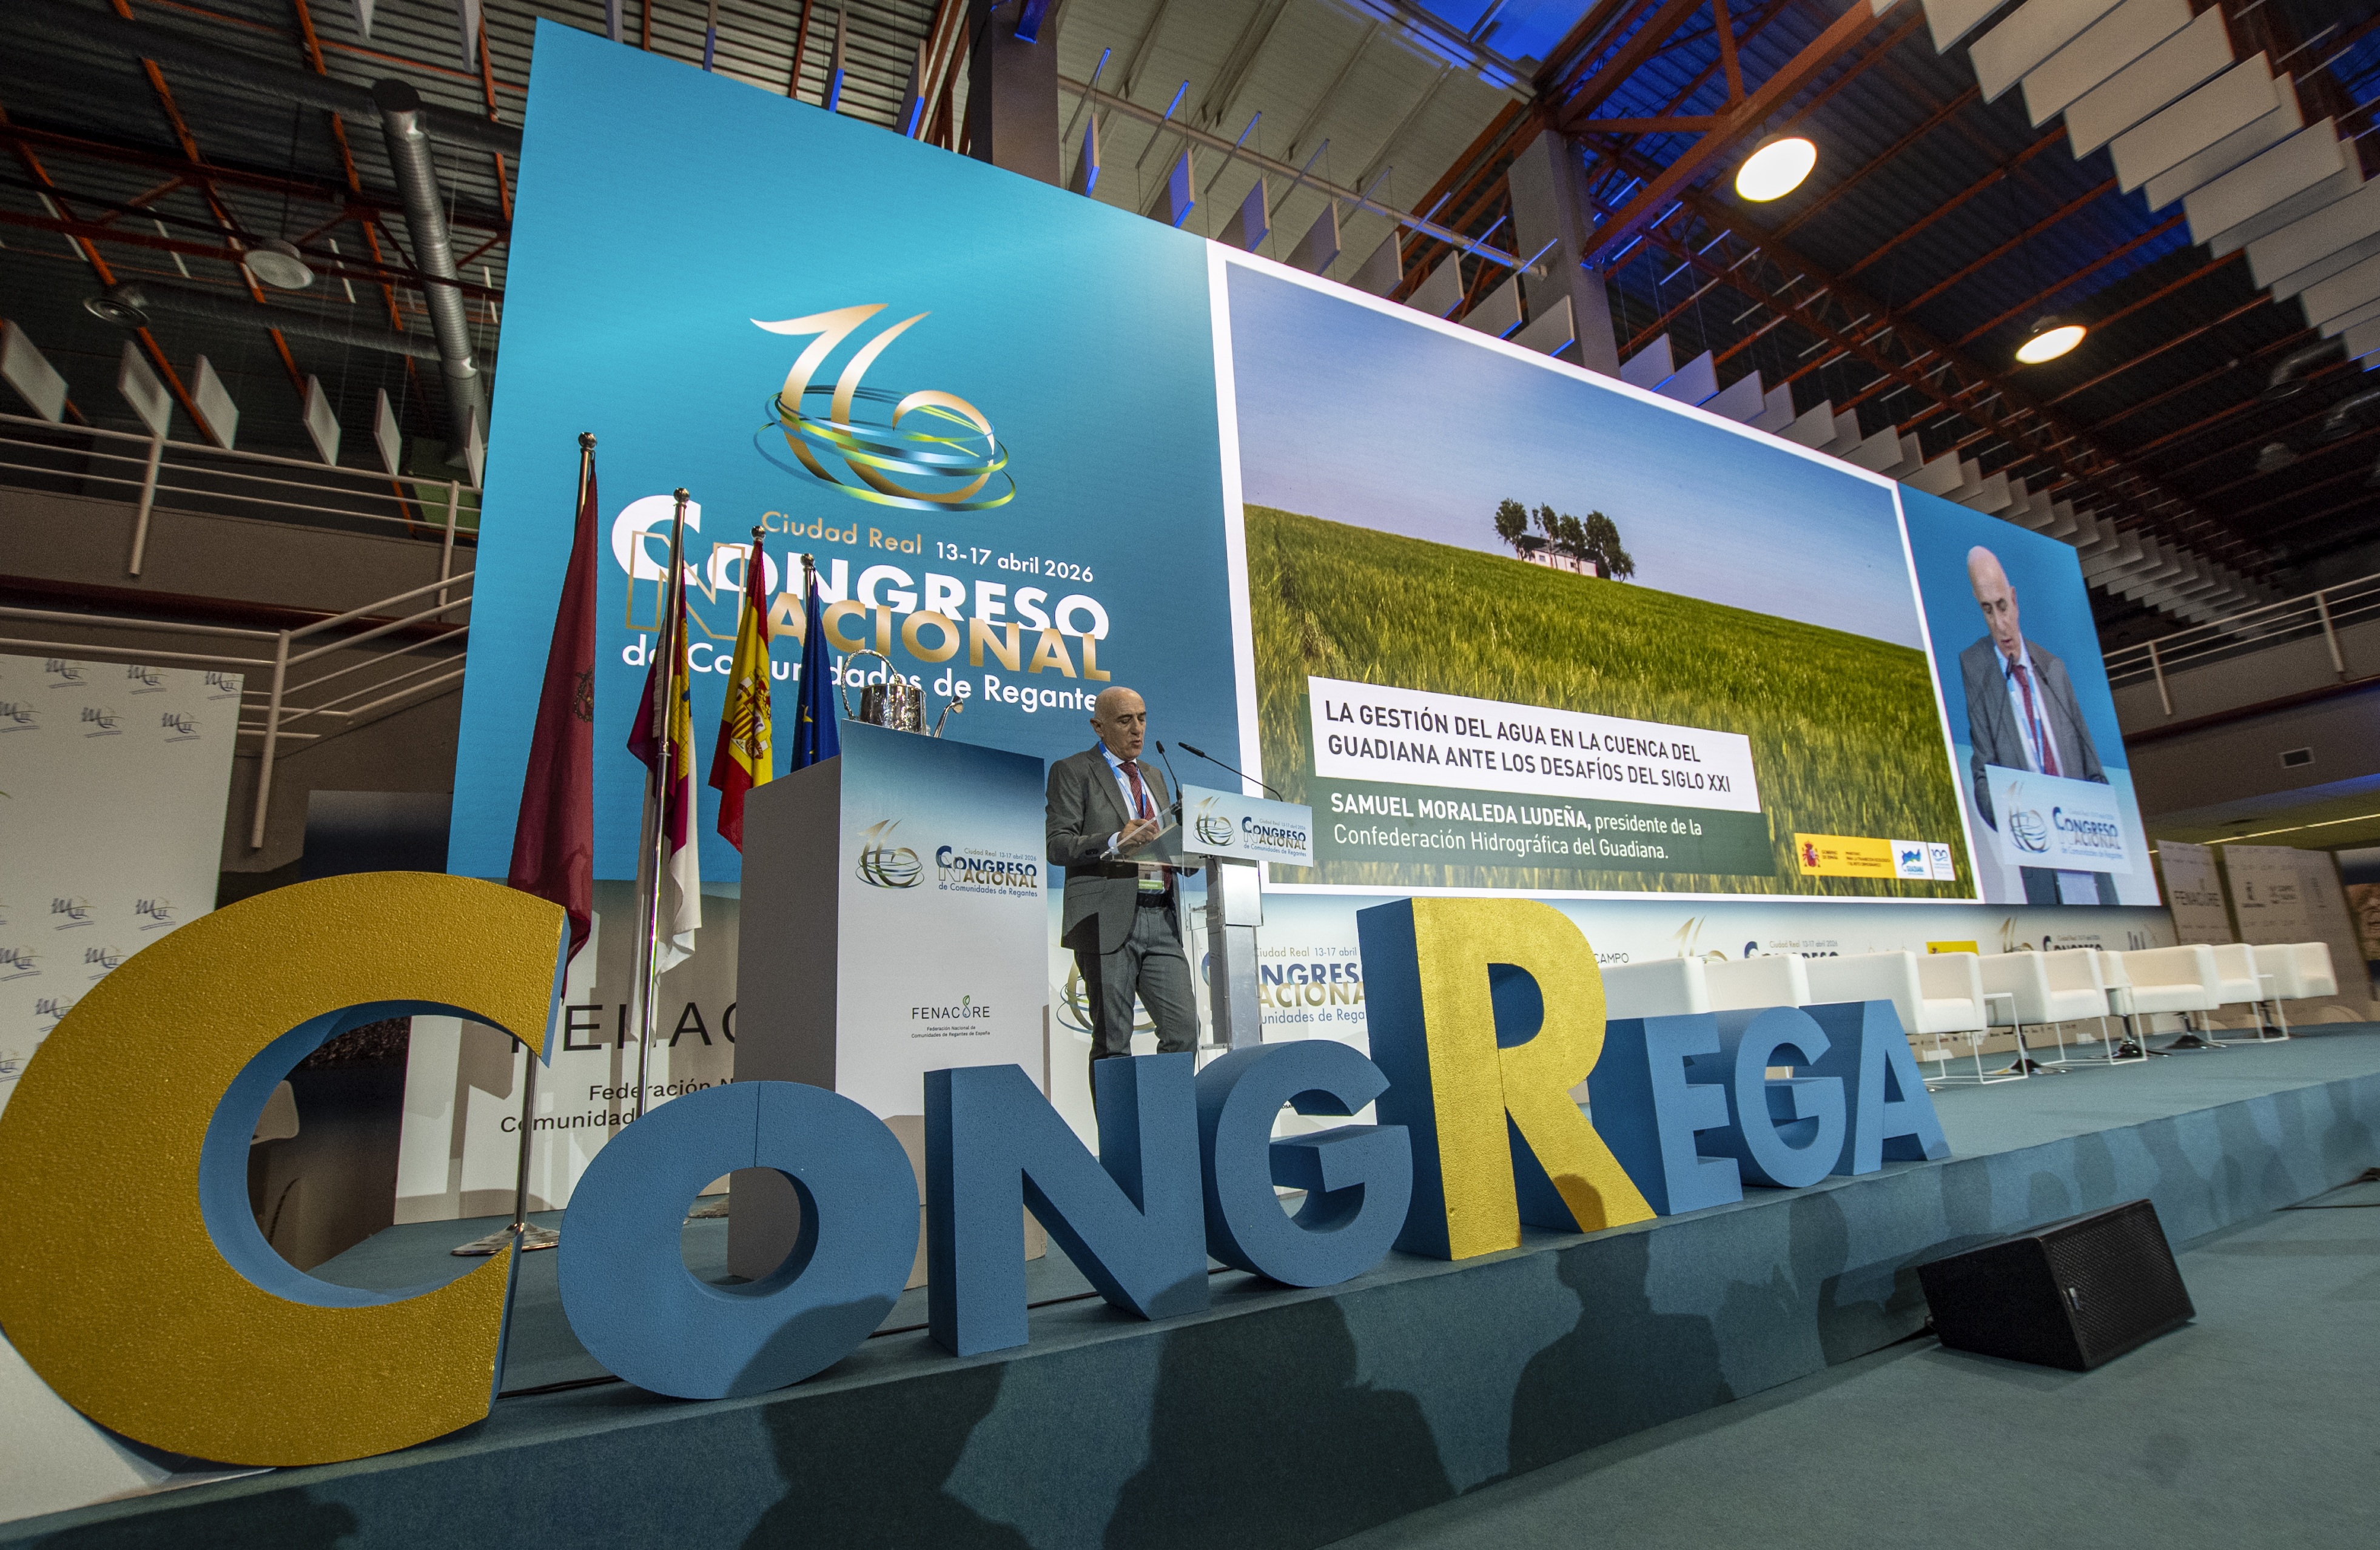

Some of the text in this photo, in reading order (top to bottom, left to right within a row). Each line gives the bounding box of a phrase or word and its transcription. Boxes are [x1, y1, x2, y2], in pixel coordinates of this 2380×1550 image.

[762, 511, 1094, 582] Ciudad Real 13-17 abril 2026
[934, 668, 972, 698] de
[984, 674, 1094, 713] Regante
[1326, 700, 1701, 763] LA GESTIÓN DEL AGUA EN LA CUENCA DEL
[1328, 734, 1731, 793] GUADIANA ANTE LOS DESAFÍOS DEL SIGLO XXI
[1242, 816, 1306, 842] CONGRESO
[1331, 793, 1703, 836] SAMUEL MORALEDA LUDEÑA, presidente de la
[1251, 844, 1280, 853] Comunidades
[1334, 824, 1669, 859] Confederación Hidrográfica del Guadiana.
[935, 845, 1037, 877] CONGRESO
[938, 854, 1038, 888] NACIONAL
[938, 882, 948, 890] de
[950, 883, 997, 894] Comunidades
[1009, 888, 1038, 898] Regantes
[1290, 947, 1309, 956] Real
[1315, 948, 1336, 956] 13-17
[1339, 947, 1357, 956] abril
[1261, 963, 1360, 985] NGRES
[1259, 981, 1365, 1008] ACIONA
[1262, 1008, 1365, 1024] unidades de Rega
